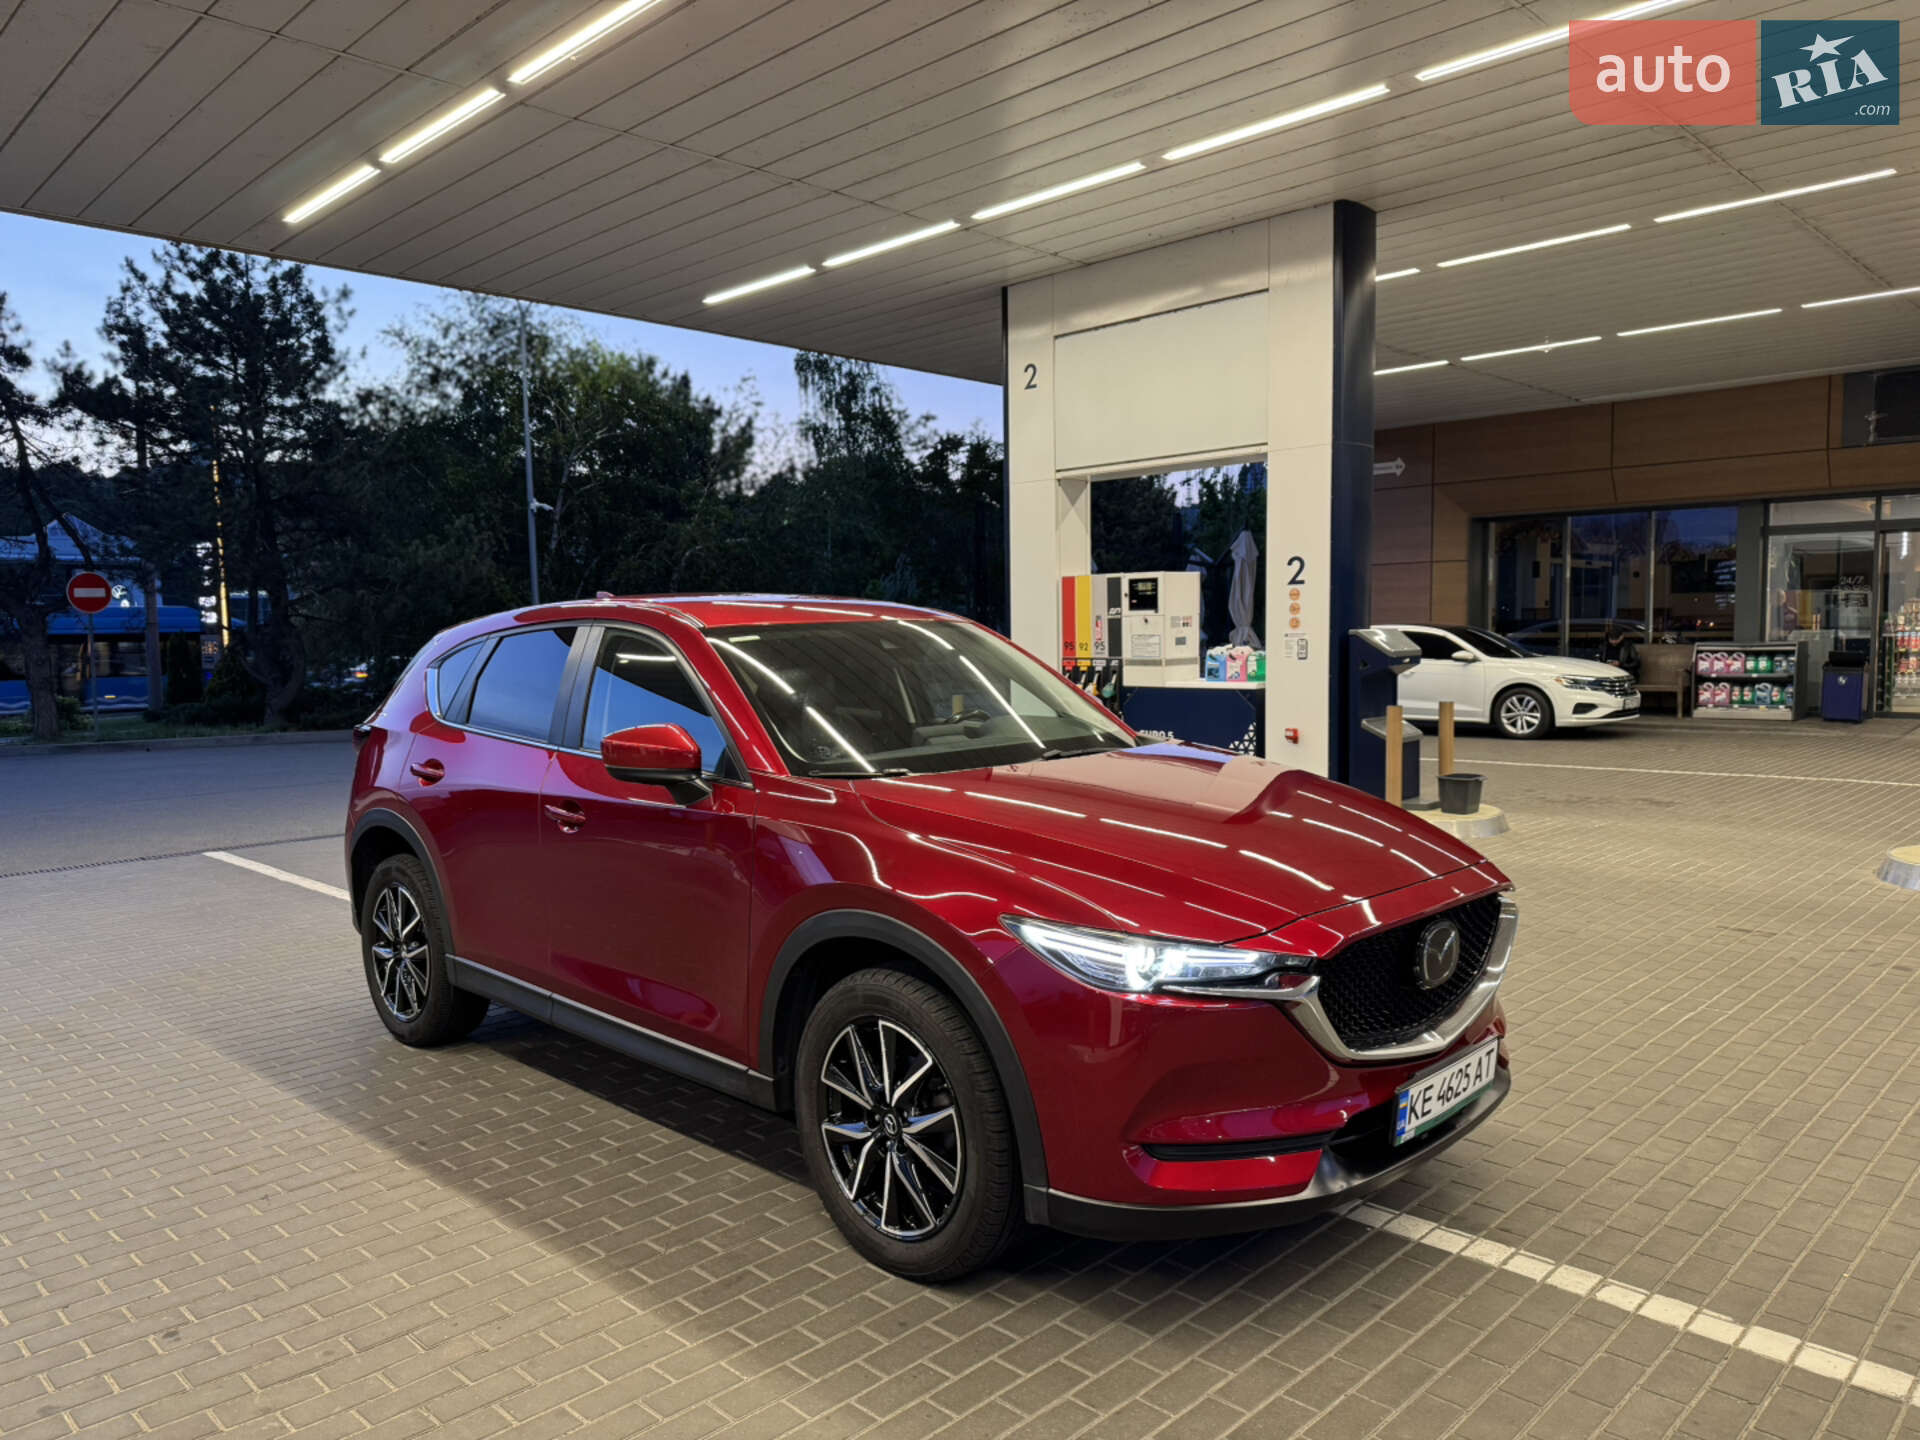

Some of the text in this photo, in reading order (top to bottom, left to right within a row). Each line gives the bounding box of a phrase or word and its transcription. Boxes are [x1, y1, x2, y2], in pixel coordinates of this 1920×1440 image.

[1023, 363, 1038, 390] 2
[1286, 556, 1306, 586] 2
[1063, 640, 1075, 651] 95
[1078, 641, 1089, 651] 92
[1094, 640, 1106, 651] 95
[1407, 1047, 1495, 1125] KE 4625 AT
